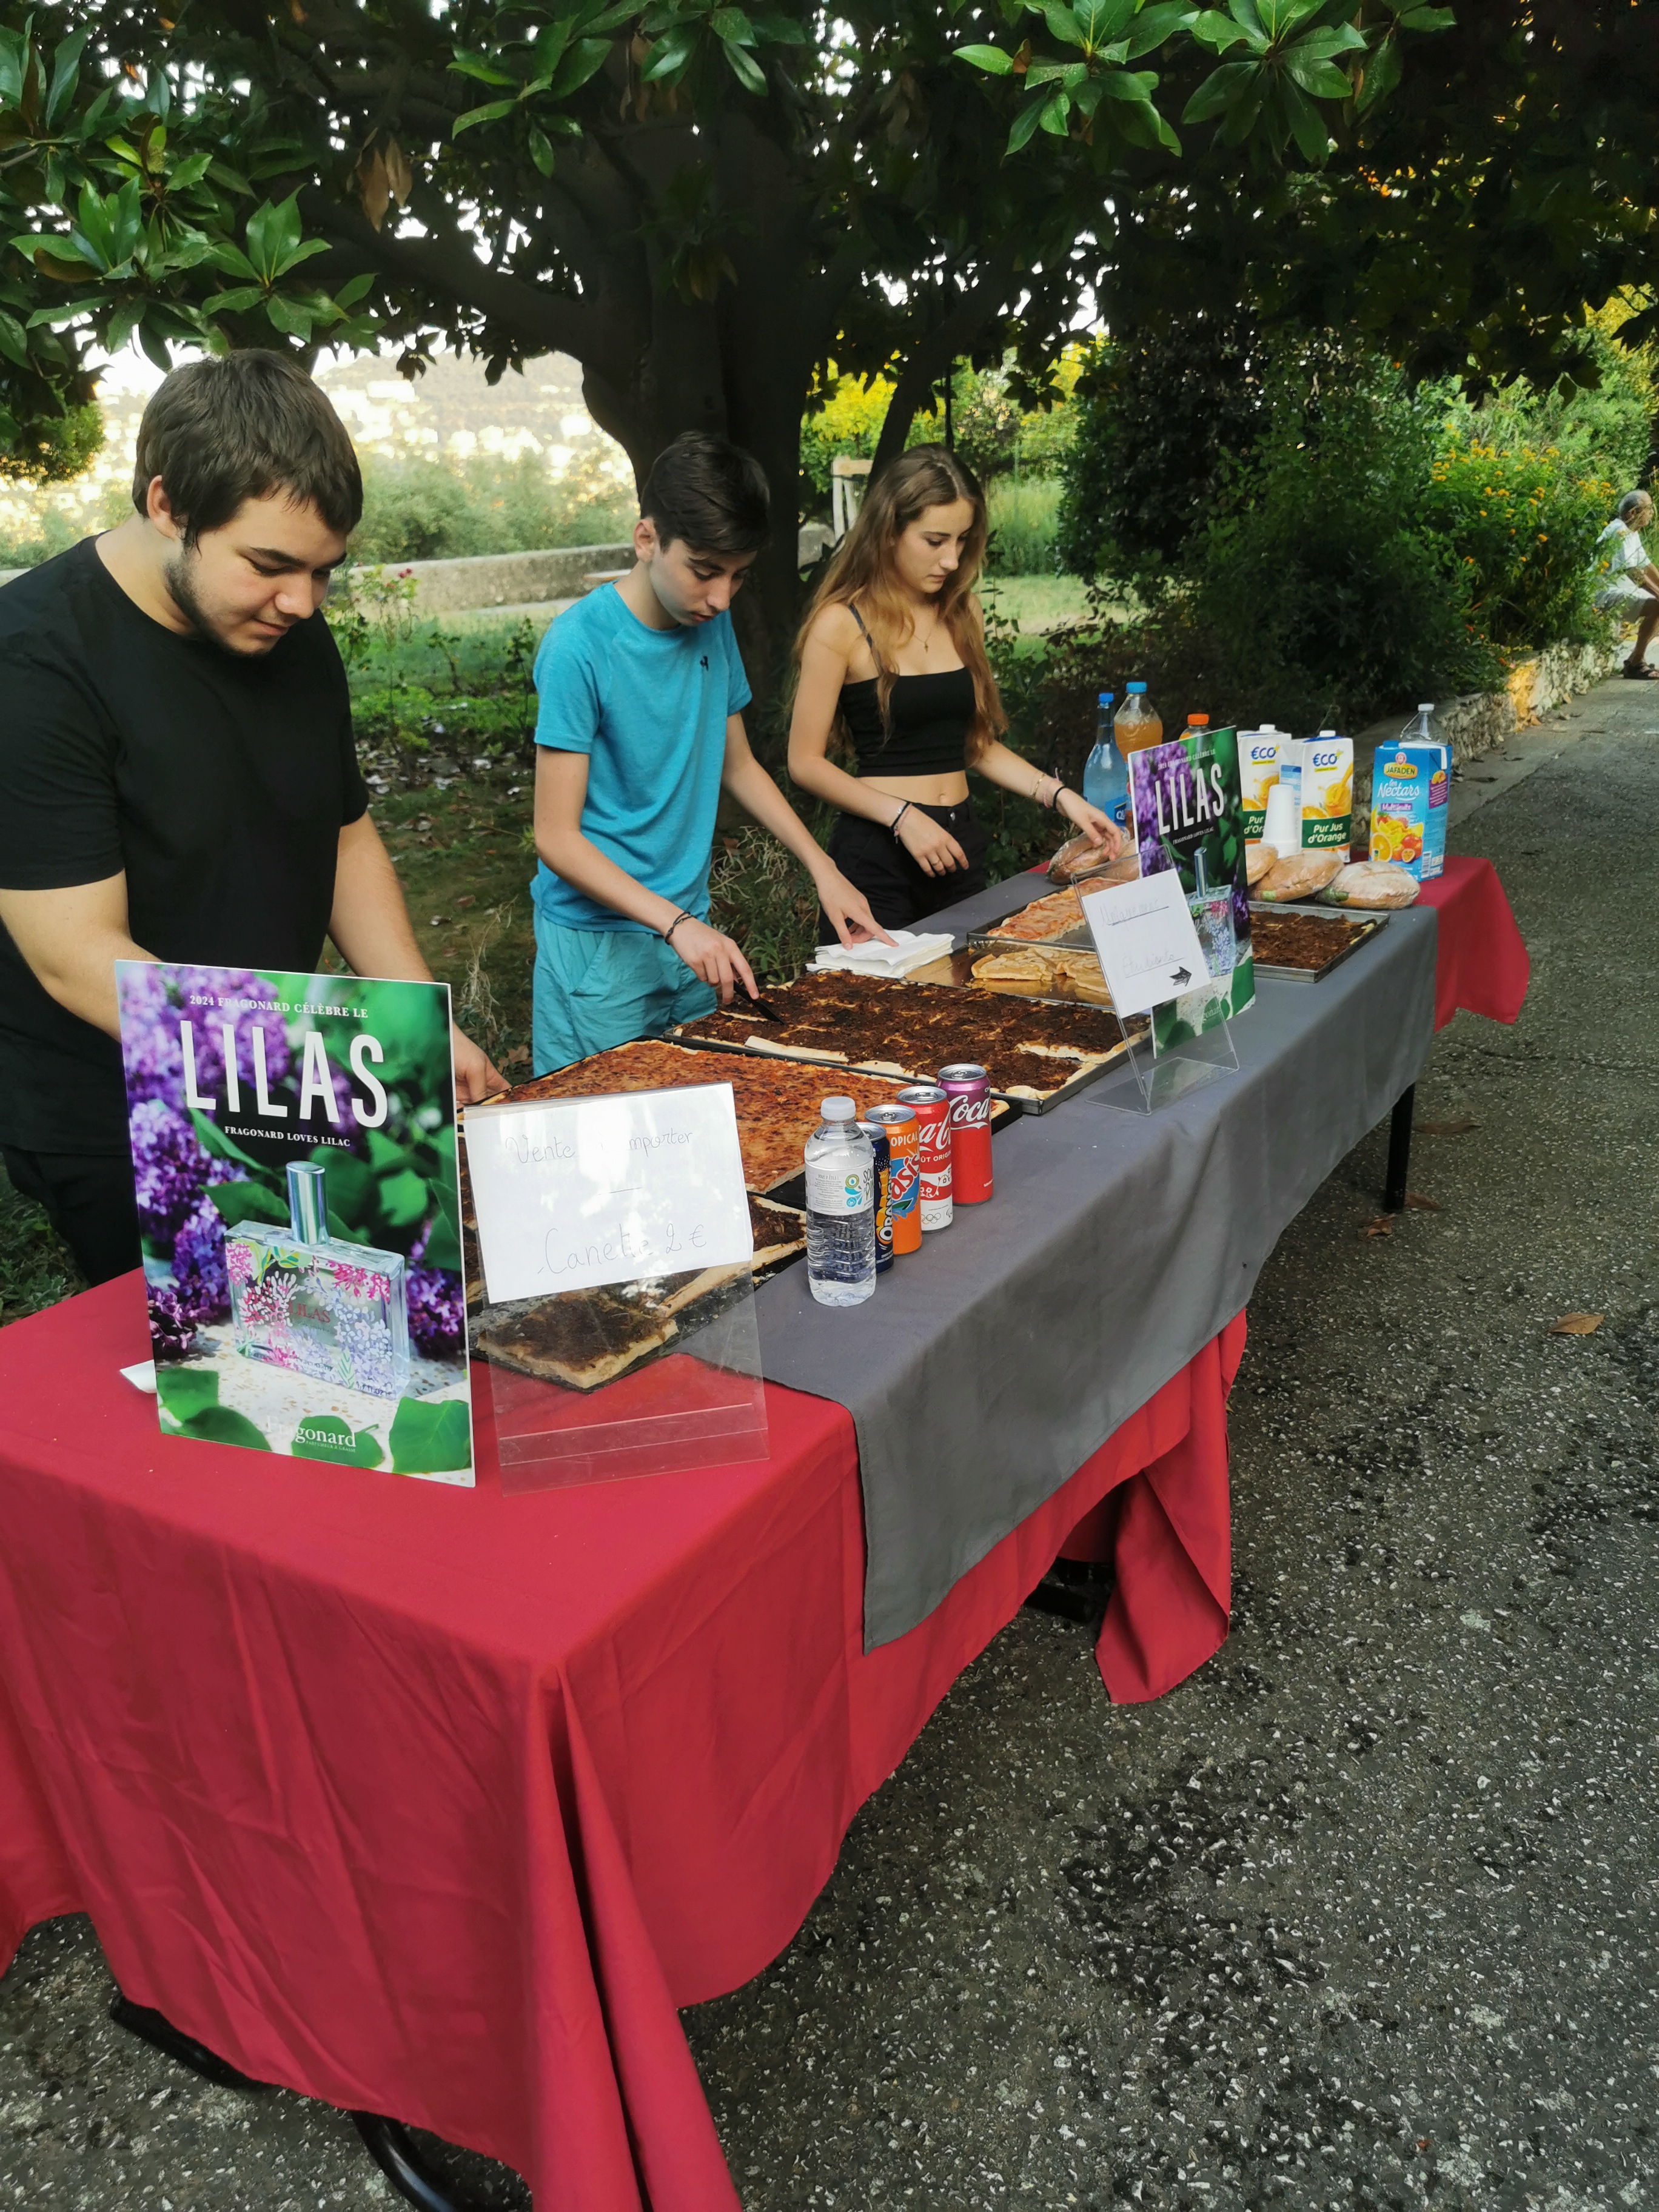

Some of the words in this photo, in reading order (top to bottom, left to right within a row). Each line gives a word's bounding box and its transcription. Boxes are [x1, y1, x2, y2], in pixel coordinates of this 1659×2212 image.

[1386, 766, 1415, 776] JAFADEN
[1155, 763, 1224, 835] LILAS
[1377, 782, 1419, 798] Nectars
[1244, 825, 1264, 834] d'Or
[1248, 816, 1264, 825] Pur
[1313, 824, 1329, 833] Pur
[1330, 823, 1343, 832] Jus
[1308, 831, 1347, 843] d'Orange
[190, 995, 214, 1005] 2024
[218, 997, 290, 1012] FRAGONARD
[294, 1002, 349, 1017] CÉLÈBRE
[354, 1008, 368, 1018] LE
[180, 1020, 387, 1128] LILAS
[224, 1126, 284, 1139] FRAGONARD
[287, 1133, 318, 1143] LOVES
[321, 1136, 350, 1147] LILAC
[505, 1134, 575, 1164] Vente
[629, 1127, 693, 1158] mporter
[891, 1131, 918, 1147] OPICAL
[666, 1222, 682, 1254] 2
[688, 1224, 707, 1248] €
[289, 1301, 330, 1323] LILAS
